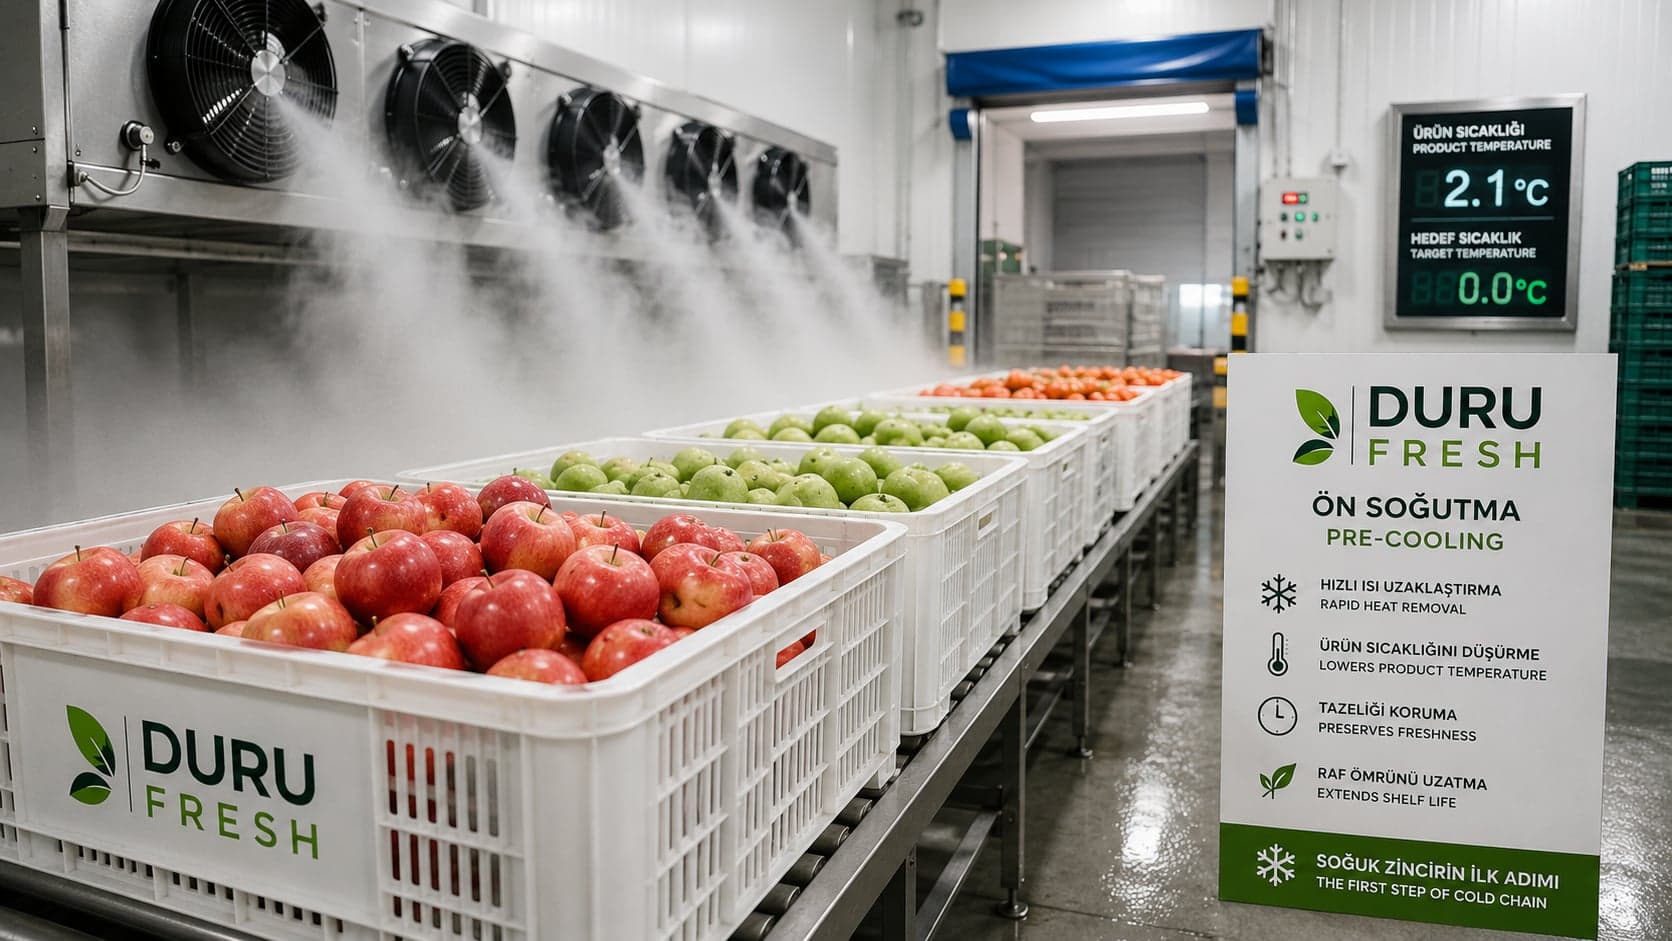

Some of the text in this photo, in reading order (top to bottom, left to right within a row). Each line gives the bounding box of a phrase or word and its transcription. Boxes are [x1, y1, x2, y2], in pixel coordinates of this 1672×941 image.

[1413, 121, 1524, 139] ÜRÜN SICAKLIĞI
[1413, 139, 1551, 154] PRODUCT TEMPERATURE
[1411, 232, 1521, 244] HEDEF SICAKLIK
[1410, 248, 1536, 259] TARGET TEMPERATURE
[1370, 386, 1541, 430] DURU
[1369, 439, 1540, 468] FRESH
[1313, 490, 1520, 521] ÖN SOĞUTMA
[1328, 529, 1503, 551] PRE-COOLING
[1321, 579, 1501, 597] HIZLI ISI UZAKLAŞTIRMA
[1320, 599, 1466, 614] RAPID HEAT REMOVAL
[1320, 637, 1539, 662] ÜRÜN SICAKLIĞINI DÜŞÜRME
[1320, 660, 1546, 680] LOWERS PRODUCT TEMPERATURE
[1319, 701, 1457, 720] TAZELİĞİ KORUMA
[1319, 723, 1476, 741] PRESERVES FRESHNESS
[142, 719, 314, 806] DURU
[1318, 767, 1487, 790] RAF ÖMRÜNÜ UZATMA
[1318, 788, 1456, 808] EXTENDS SHELF LIFE
[146, 785, 319, 860] FRESH
[1317, 853, 1558, 889] SOĞUK ZİNCİRİN İLK ADIMI
[1316, 876, 1546, 909] THE FIRST STEP OF COLD CHAIN
